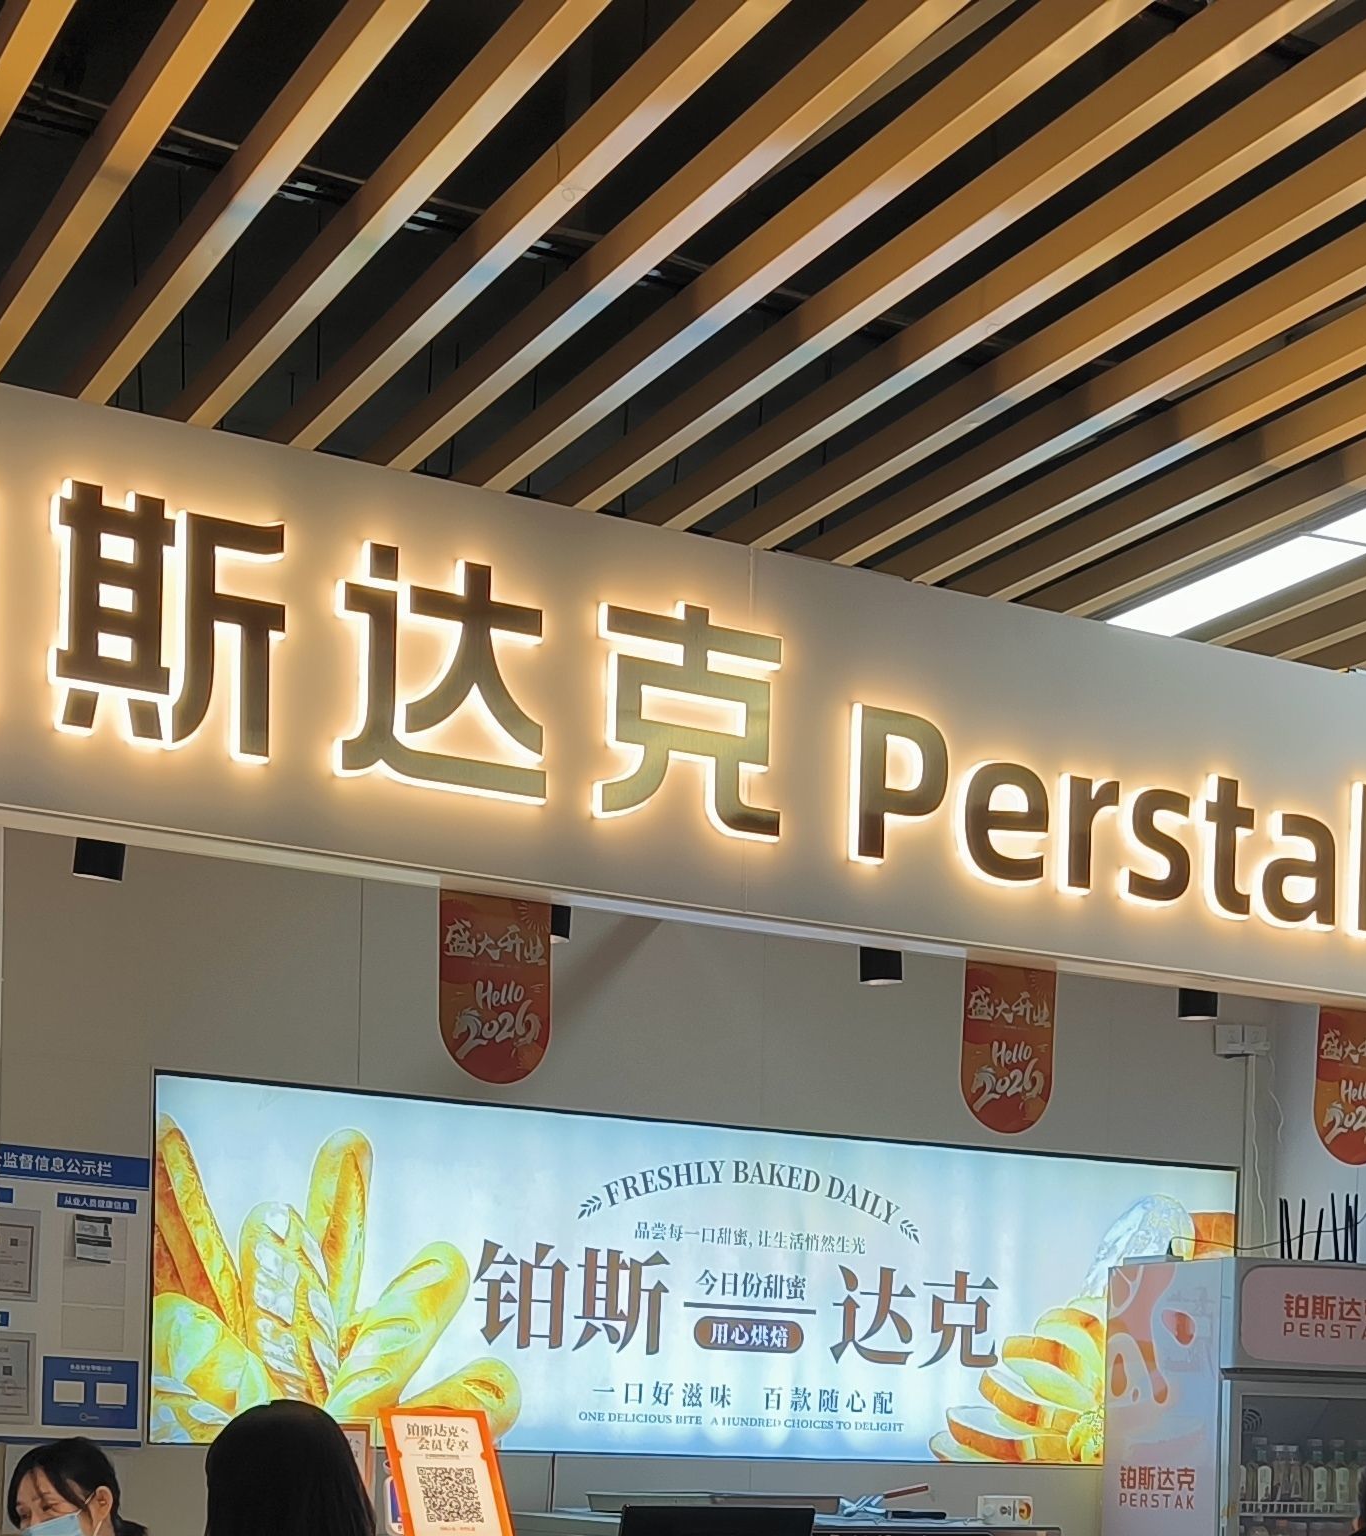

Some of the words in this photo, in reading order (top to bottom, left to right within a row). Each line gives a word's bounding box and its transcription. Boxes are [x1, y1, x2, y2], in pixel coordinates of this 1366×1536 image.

[475, 980, 525, 1010] Hello
[453, 1000, 542, 1060] 2026
[992, 1041, 1032, 1067] Hello
[971, 1058, 1044, 1112] 2026
[602, 1160, 727, 1207] FRESHLY
[733, 1160, 820, 1193] BAKED
[825, 1175, 901, 1225] DAILY
[473, 1238, 671, 1356] 铂斯
[694, 1268, 808, 1303] 今日份甜蜜
[828, 1263, 999, 1369] 达克
[709, 1321, 791, 1348] 用心烘焙
[593, 1381, 732, 1409] 一口好滋味
[763, 1385, 895, 1415] 百款随心配
[579, 1411, 605, 1422] ONE
[608, 1412, 672, 1425] DELICIOUS
[1119, 1465, 1196, 1491] 铂斯达克
[1119, 1492, 1195, 1510] PERSTAK
